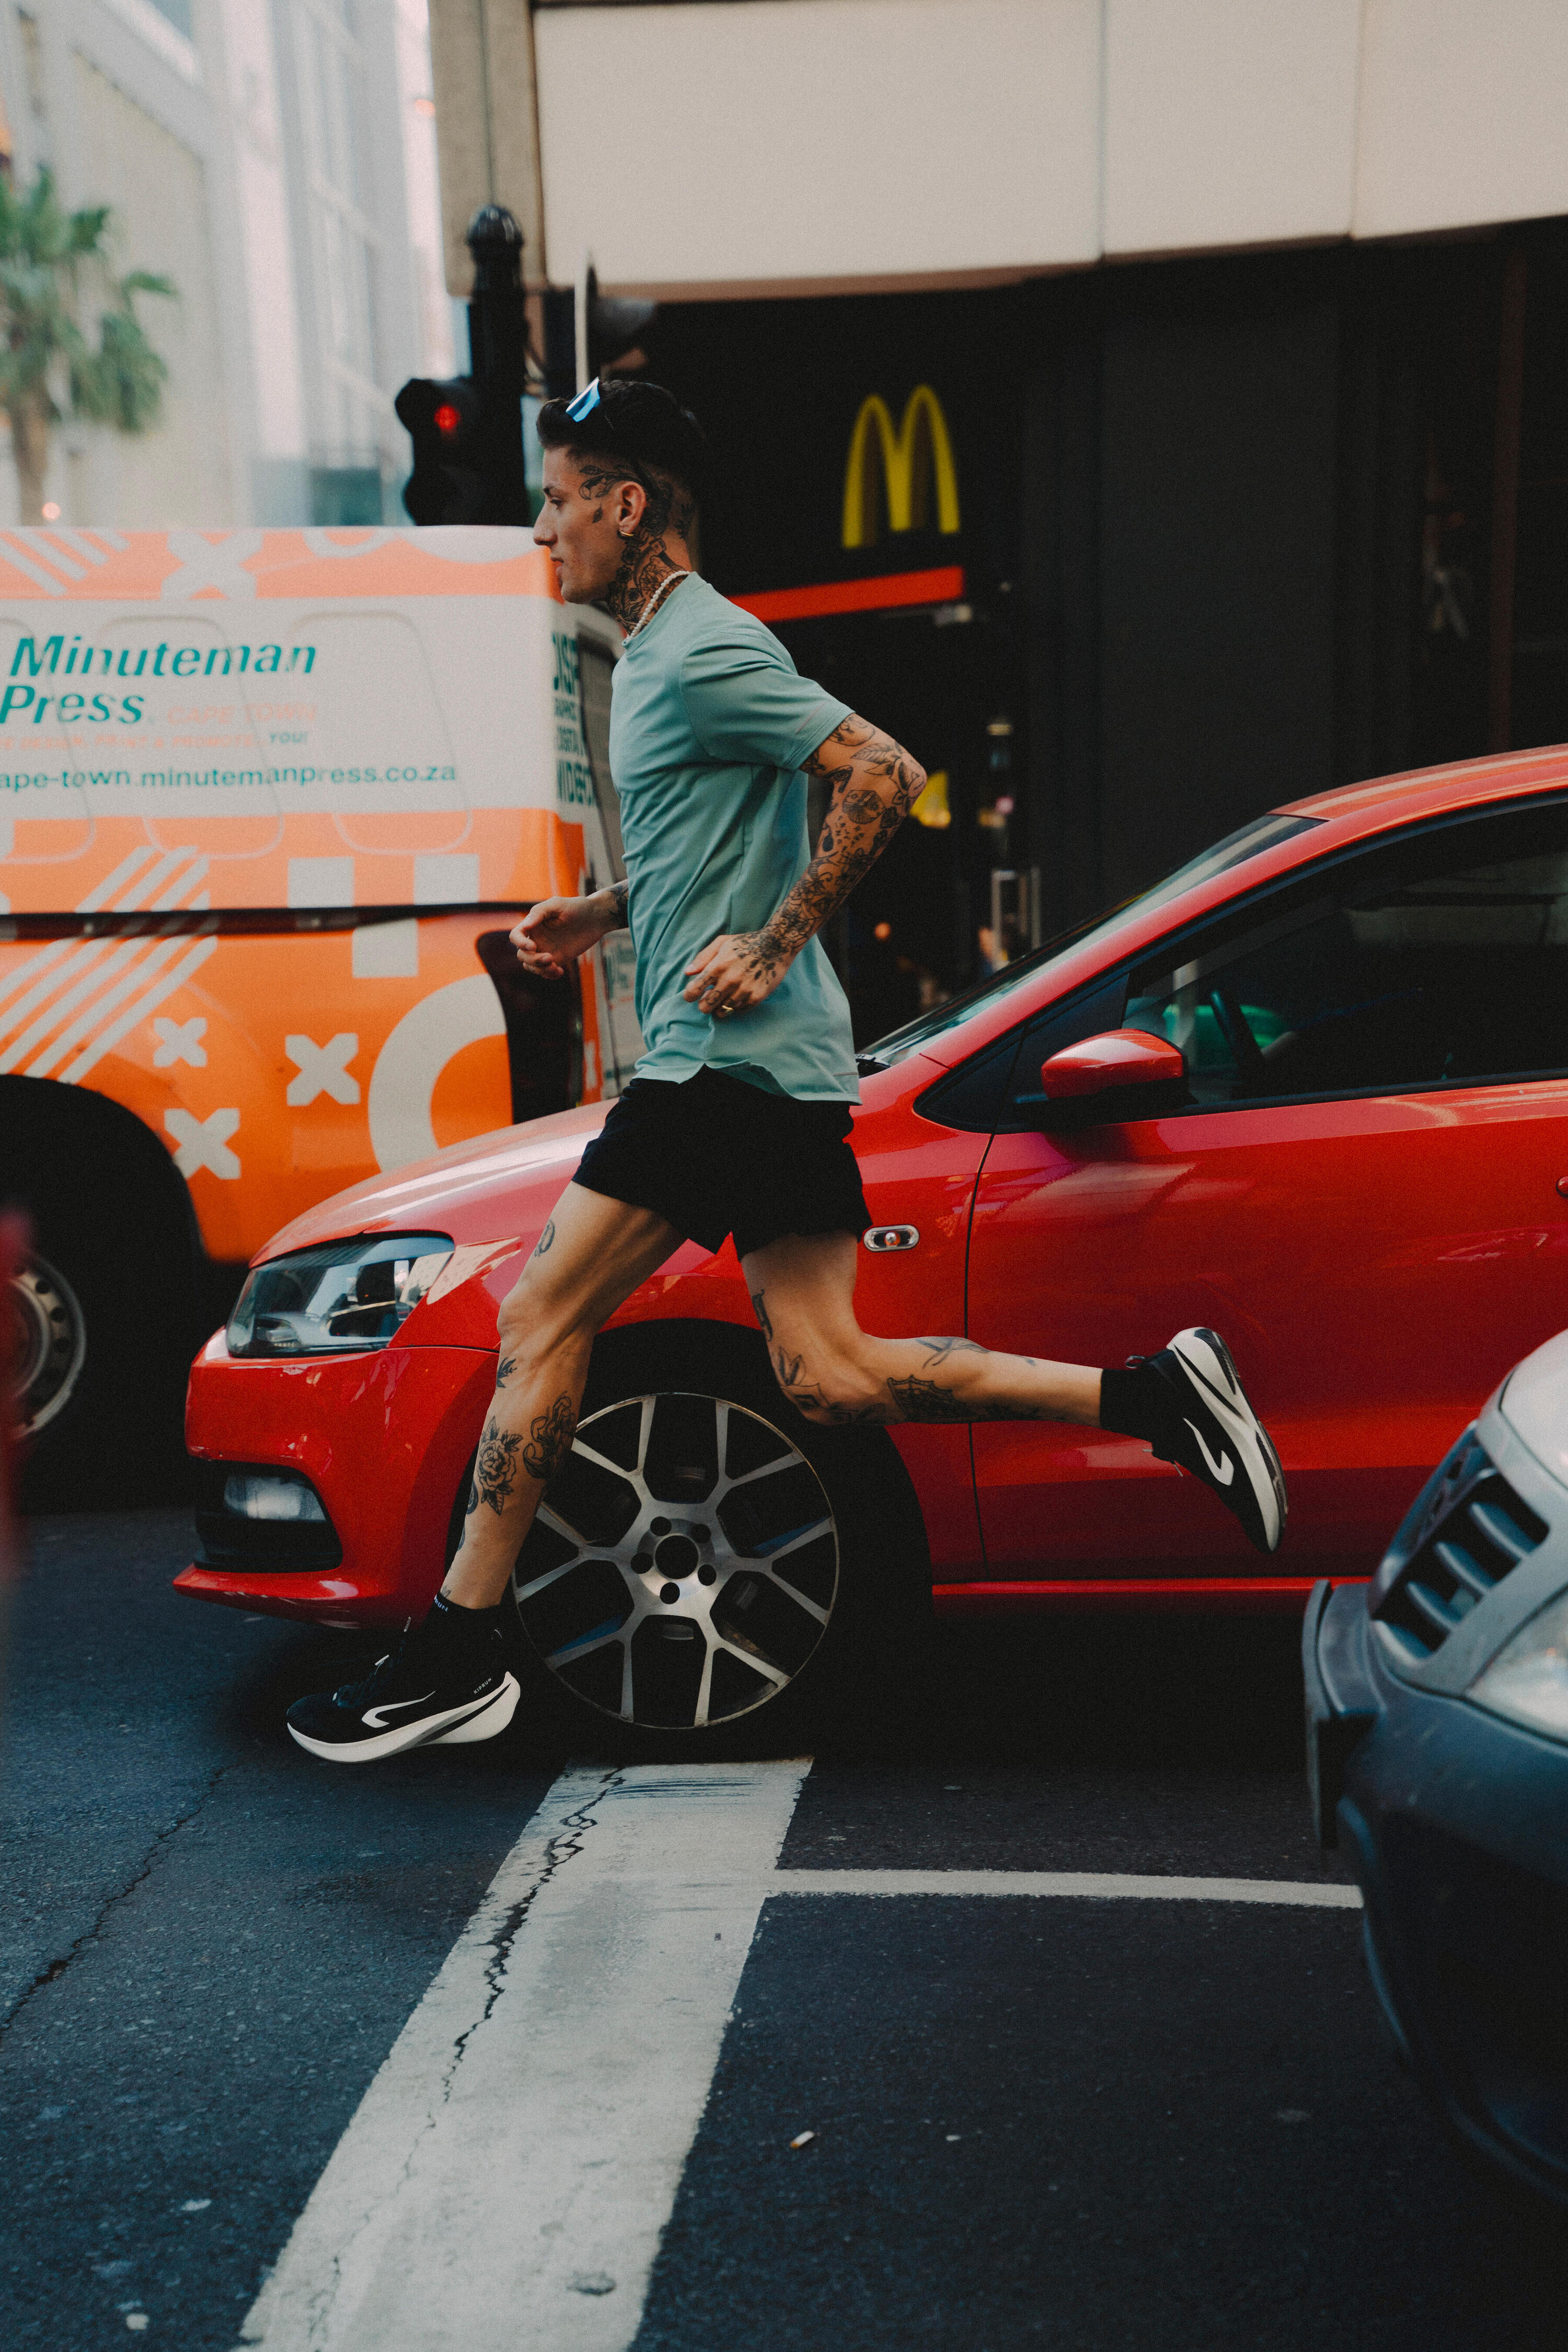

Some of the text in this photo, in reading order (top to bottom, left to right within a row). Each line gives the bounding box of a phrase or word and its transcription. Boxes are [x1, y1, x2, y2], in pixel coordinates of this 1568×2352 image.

[9, 635, 317, 677] Minuteman
[0, 685, 145, 724] Press
[166, 702, 318, 725] CAPE TOWN
[473, 1677, 492, 1694] KIPRUN
